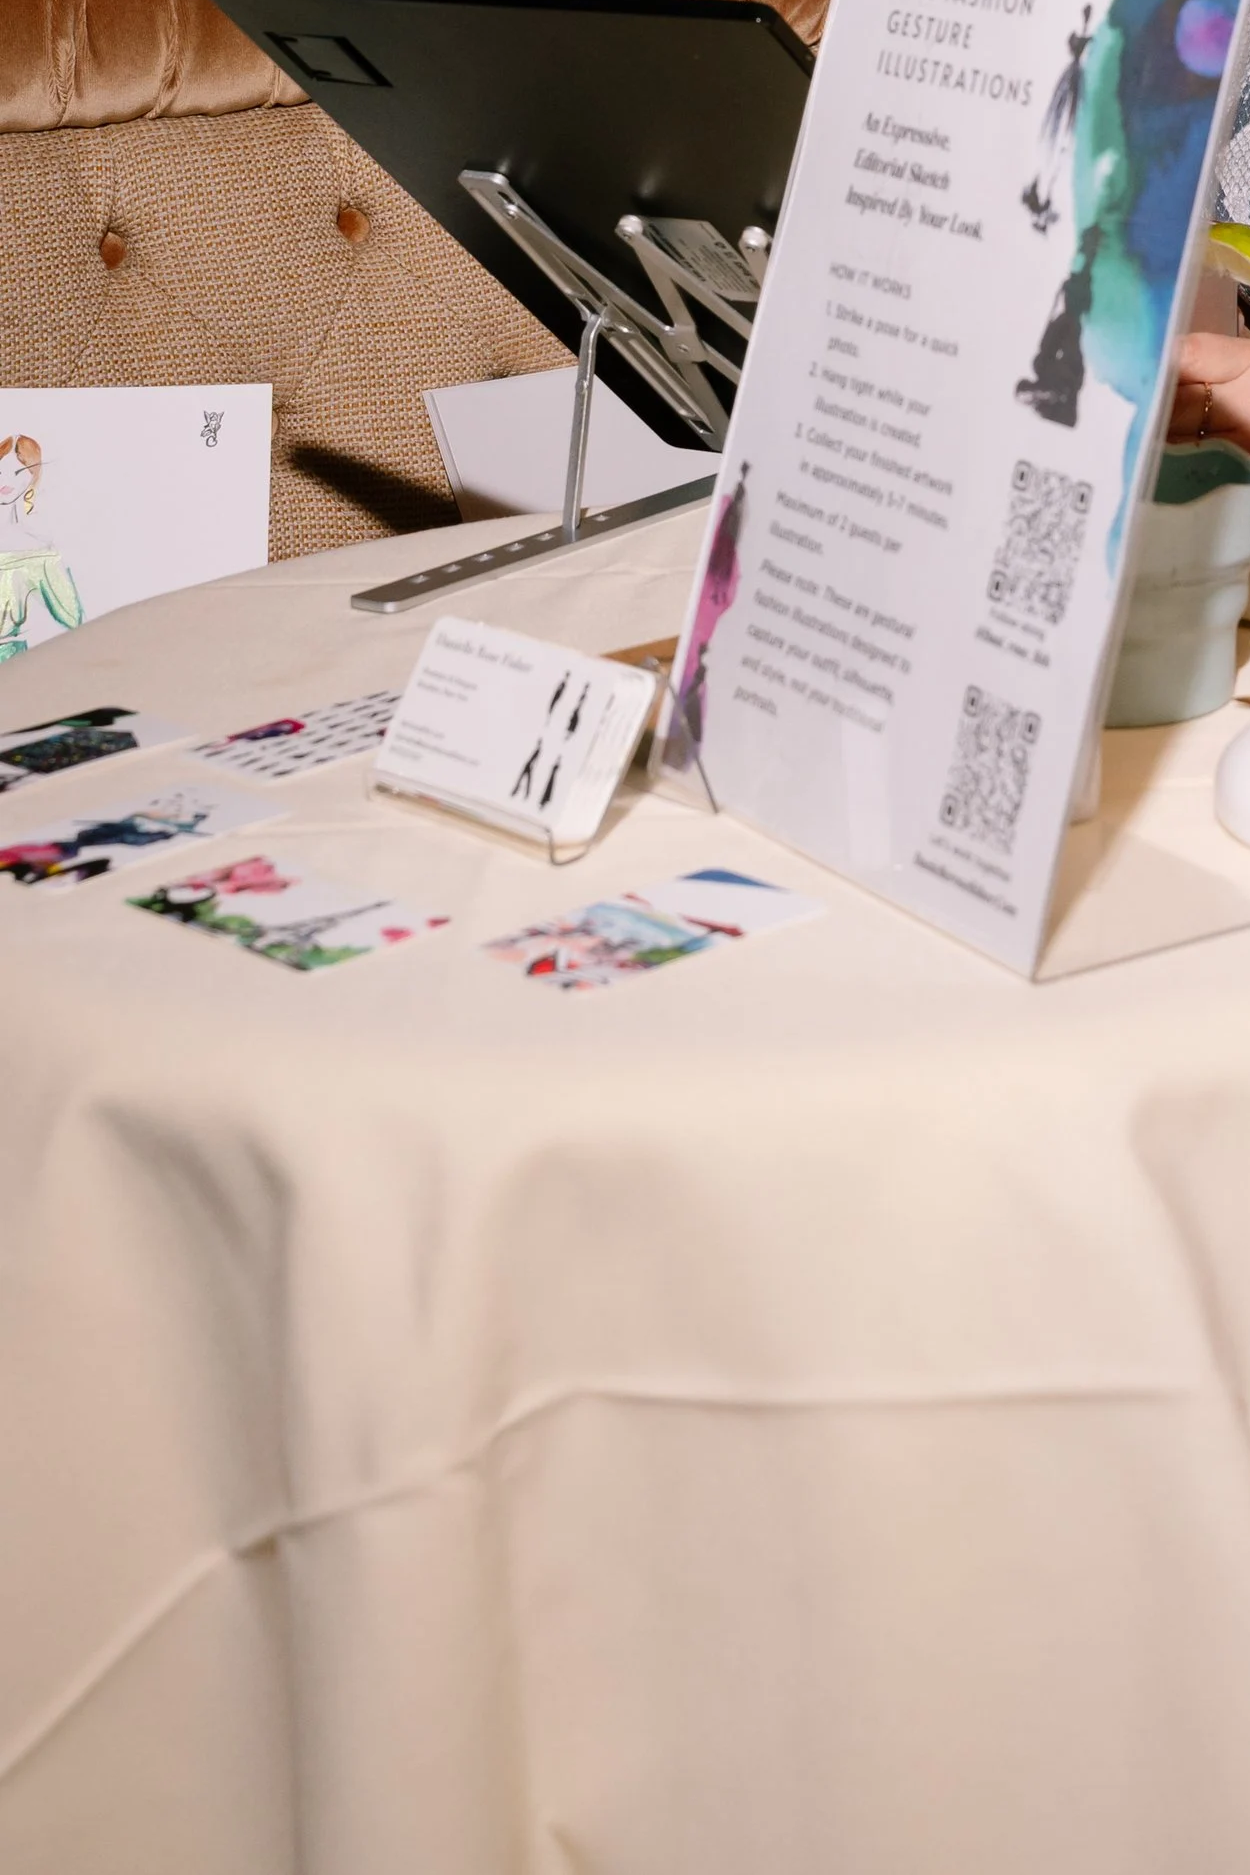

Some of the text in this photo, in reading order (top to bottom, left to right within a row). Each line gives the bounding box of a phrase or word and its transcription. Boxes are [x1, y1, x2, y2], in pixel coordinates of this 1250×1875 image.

[886, 9, 973, 50] GESTURE
[876, 49, 1033, 107] ILLUSTRATIONS
[865, 112, 881, 133] An
[853, 148, 950, 190] Editorial Sketch
[844, 185, 899, 217] Inspired
[897, 199, 914, 226] By
[918, 204, 950, 230] Your
[830, 264, 911, 300] HOW IT WORKS
[835, 303, 864, 327] Strike
[865, 317, 874, 330] a
[874, 320, 901, 339] pose
[902, 325, 920, 344] for
[920, 336, 928, 348] a
[929, 337, 959, 357] quick
[814, 395, 868, 427] illustration
[868, 418, 879, 433] is
[850, 377, 876, 397] tight
[876, 389, 905, 408] while
[906, 399, 932, 417] your
[799, 459, 810, 473] in
[810, 464, 884, 505] approximately
[806, 427, 844, 453] Collect
[843, 445, 870, 463] your
[869, 450, 913, 480] finished
[911, 471, 953, 496] artwork
[776, 490, 825, 522] Maximum
[825, 513, 840, 527] of
[848, 522, 882, 547] guests
[881, 537, 903, 554] per
[759, 558, 794, 585] Please
[823, 585, 854, 611] These
[853, 603, 871, 619] are
[870, 611, 916, 640] gestural
[746, 623, 786, 650] capture
[785, 643, 811, 662] your
[753, 588, 791, 617] fashion
[790, 606, 850, 646] illustrations
[849, 635, 899, 669] designed
[740, 655, 762, 673] and
